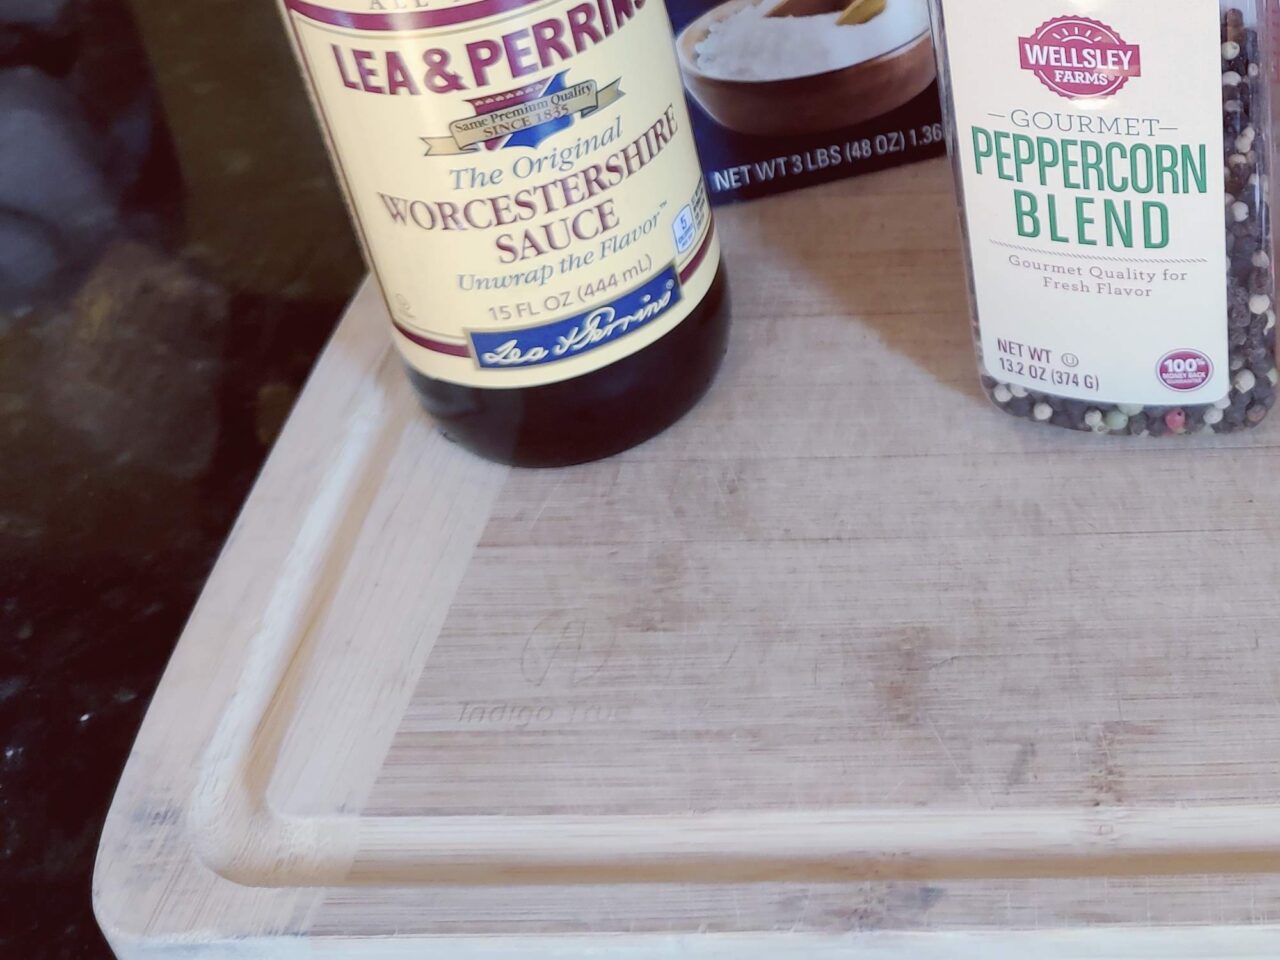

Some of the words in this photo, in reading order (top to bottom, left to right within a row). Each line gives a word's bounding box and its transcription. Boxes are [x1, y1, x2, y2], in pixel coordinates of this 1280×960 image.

[1024, 43, 1133, 71] WELLSLEY
[1054, 69, 1108, 87] FARMS
[454, 117, 489, 133] Same
[490, 100, 550, 124] Premium
[551, 83, 593, 107] Quality
[483, 117, 531, 138] SINCE
[1010, 109, 1160, 137] GOURMET
[377, 103, 680, 233] WORCESTERSHIRE
[450, 164, 504, 192] The
[512, 116, 624, 181] Original
[714, 164, 751, 192] NET
[755, 156, 788, 182] WT
[792, 153, 804, 174] 3
[805, 145, 842, 171] LBS
[845, 138, 872, 164] (48
[875, 129, 906, 157] OZ)
[971, 125, 1208, 194] PEPPERCORN
[495, 197, 621, 265] SAUCE
[1013, 189, 1171, 249] BLEND
[457, 262, 554, 293] Unwrap
[559, 246, 595, 274] the
[488, 305, 512, 322] 15
[516, 302, 540, 318] FL
[544, 292, 574, 312] OZ
[578, 275, 618, 303] (444
[622, 254, 653, 285] mL)
[1008, 254, 1083, 276] Gourmet
[1089, 265, 1157, 284] Quality
[1163, 268, 1188, 282] for
[1043, 276, 1090, 294] Fresh
[1097, 282, 1153, 297] Flavor
[997, 338, 1025, 357] NET
[1028, 346, 1053, 364] WT
[999, 357, 1026, 376] 13.2
[1028, 366, 1047, 381] OZ
[1051, 371, 1079, 388] (374
[1084, 376, 1100, 392] G)
